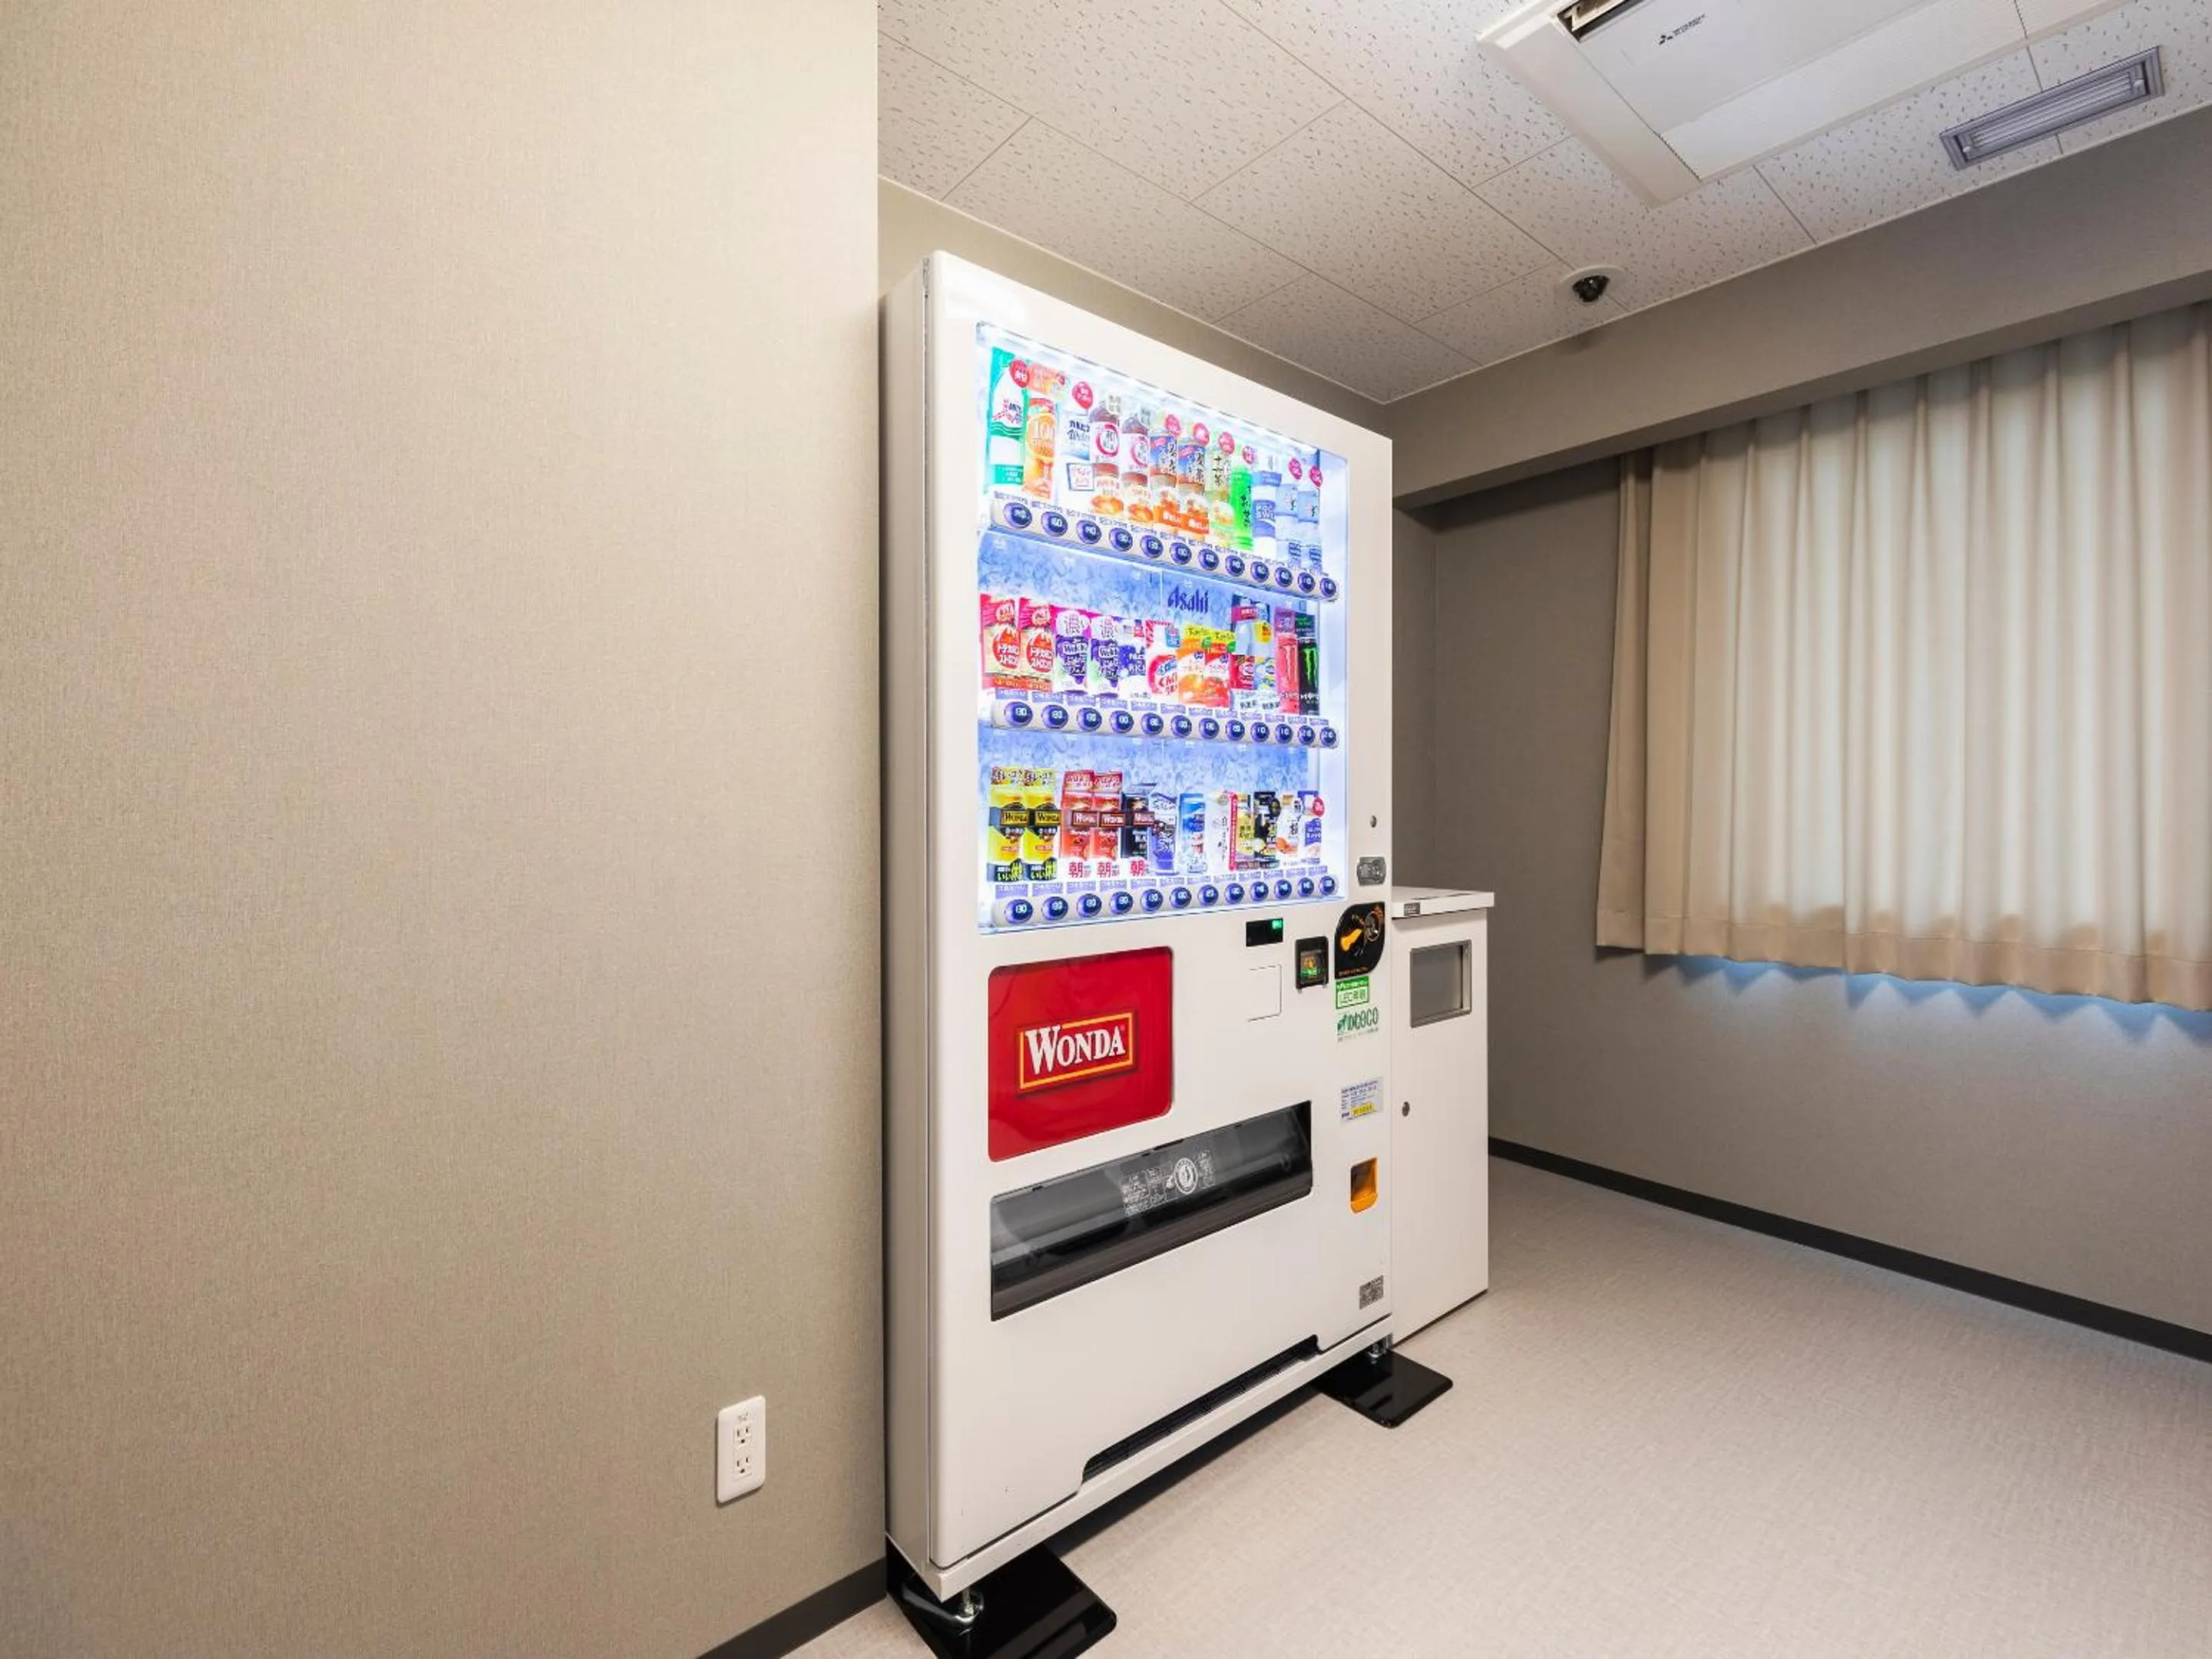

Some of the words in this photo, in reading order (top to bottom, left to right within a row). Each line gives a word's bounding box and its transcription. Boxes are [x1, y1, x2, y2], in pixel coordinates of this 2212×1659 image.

[1167, 584, 1208, 614] Asahi
[1068, 861, 1084, 878] 朝
[1098, 862, 1111, 878] 朝
[1131, 859, 1145, 876] 朝
[1025, 1024, 1126, 1075] WONDA
